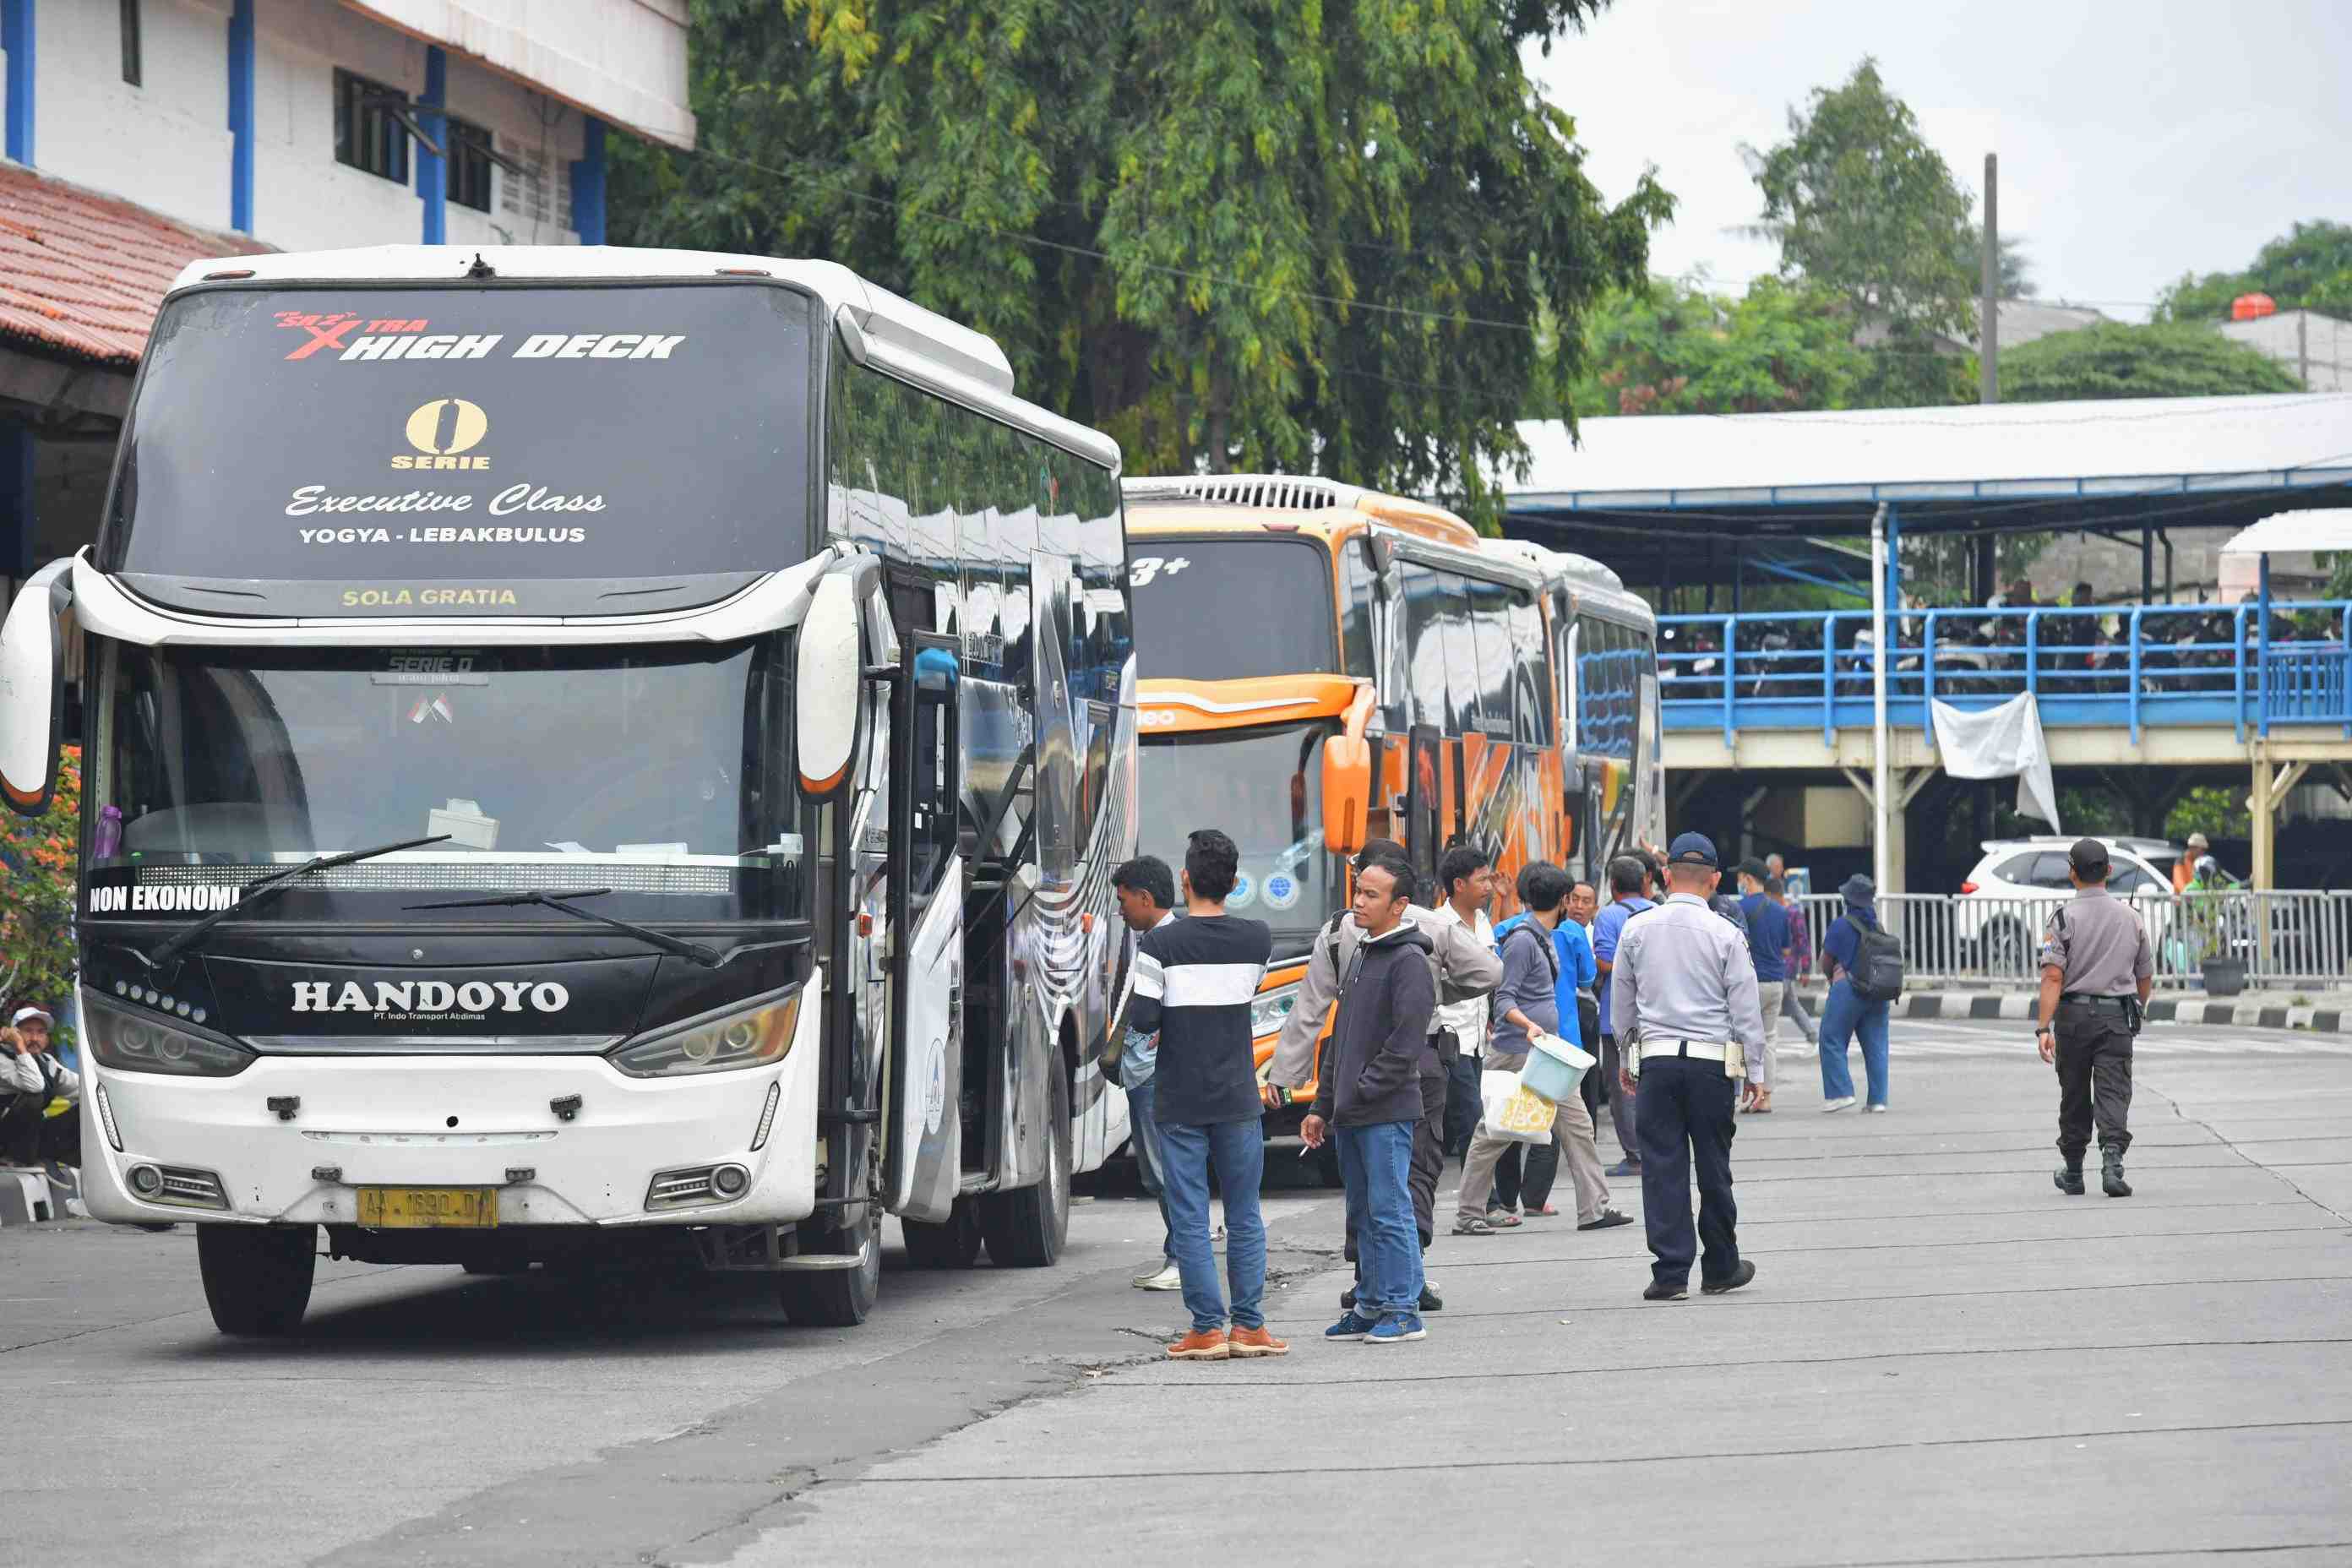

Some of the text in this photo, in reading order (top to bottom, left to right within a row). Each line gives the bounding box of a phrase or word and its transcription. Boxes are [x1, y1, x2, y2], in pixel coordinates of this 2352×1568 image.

[338, 334, 684, 361] HIGH DECK
[391, 455, 490, 470] SERIE
[285, 482, 607, 517] Executive Class
[299, 527, 390, 545] YOGYA
[409, 526, 585, 543] LEBAKBULUS
[343, 589, 516, 607] SOLA GRATIA
[90, 885, 240, 912] NON EKONOMI
[291, 981, 569, 1012] HANDOYO
[408, 1012, 448, 1021] Transport
